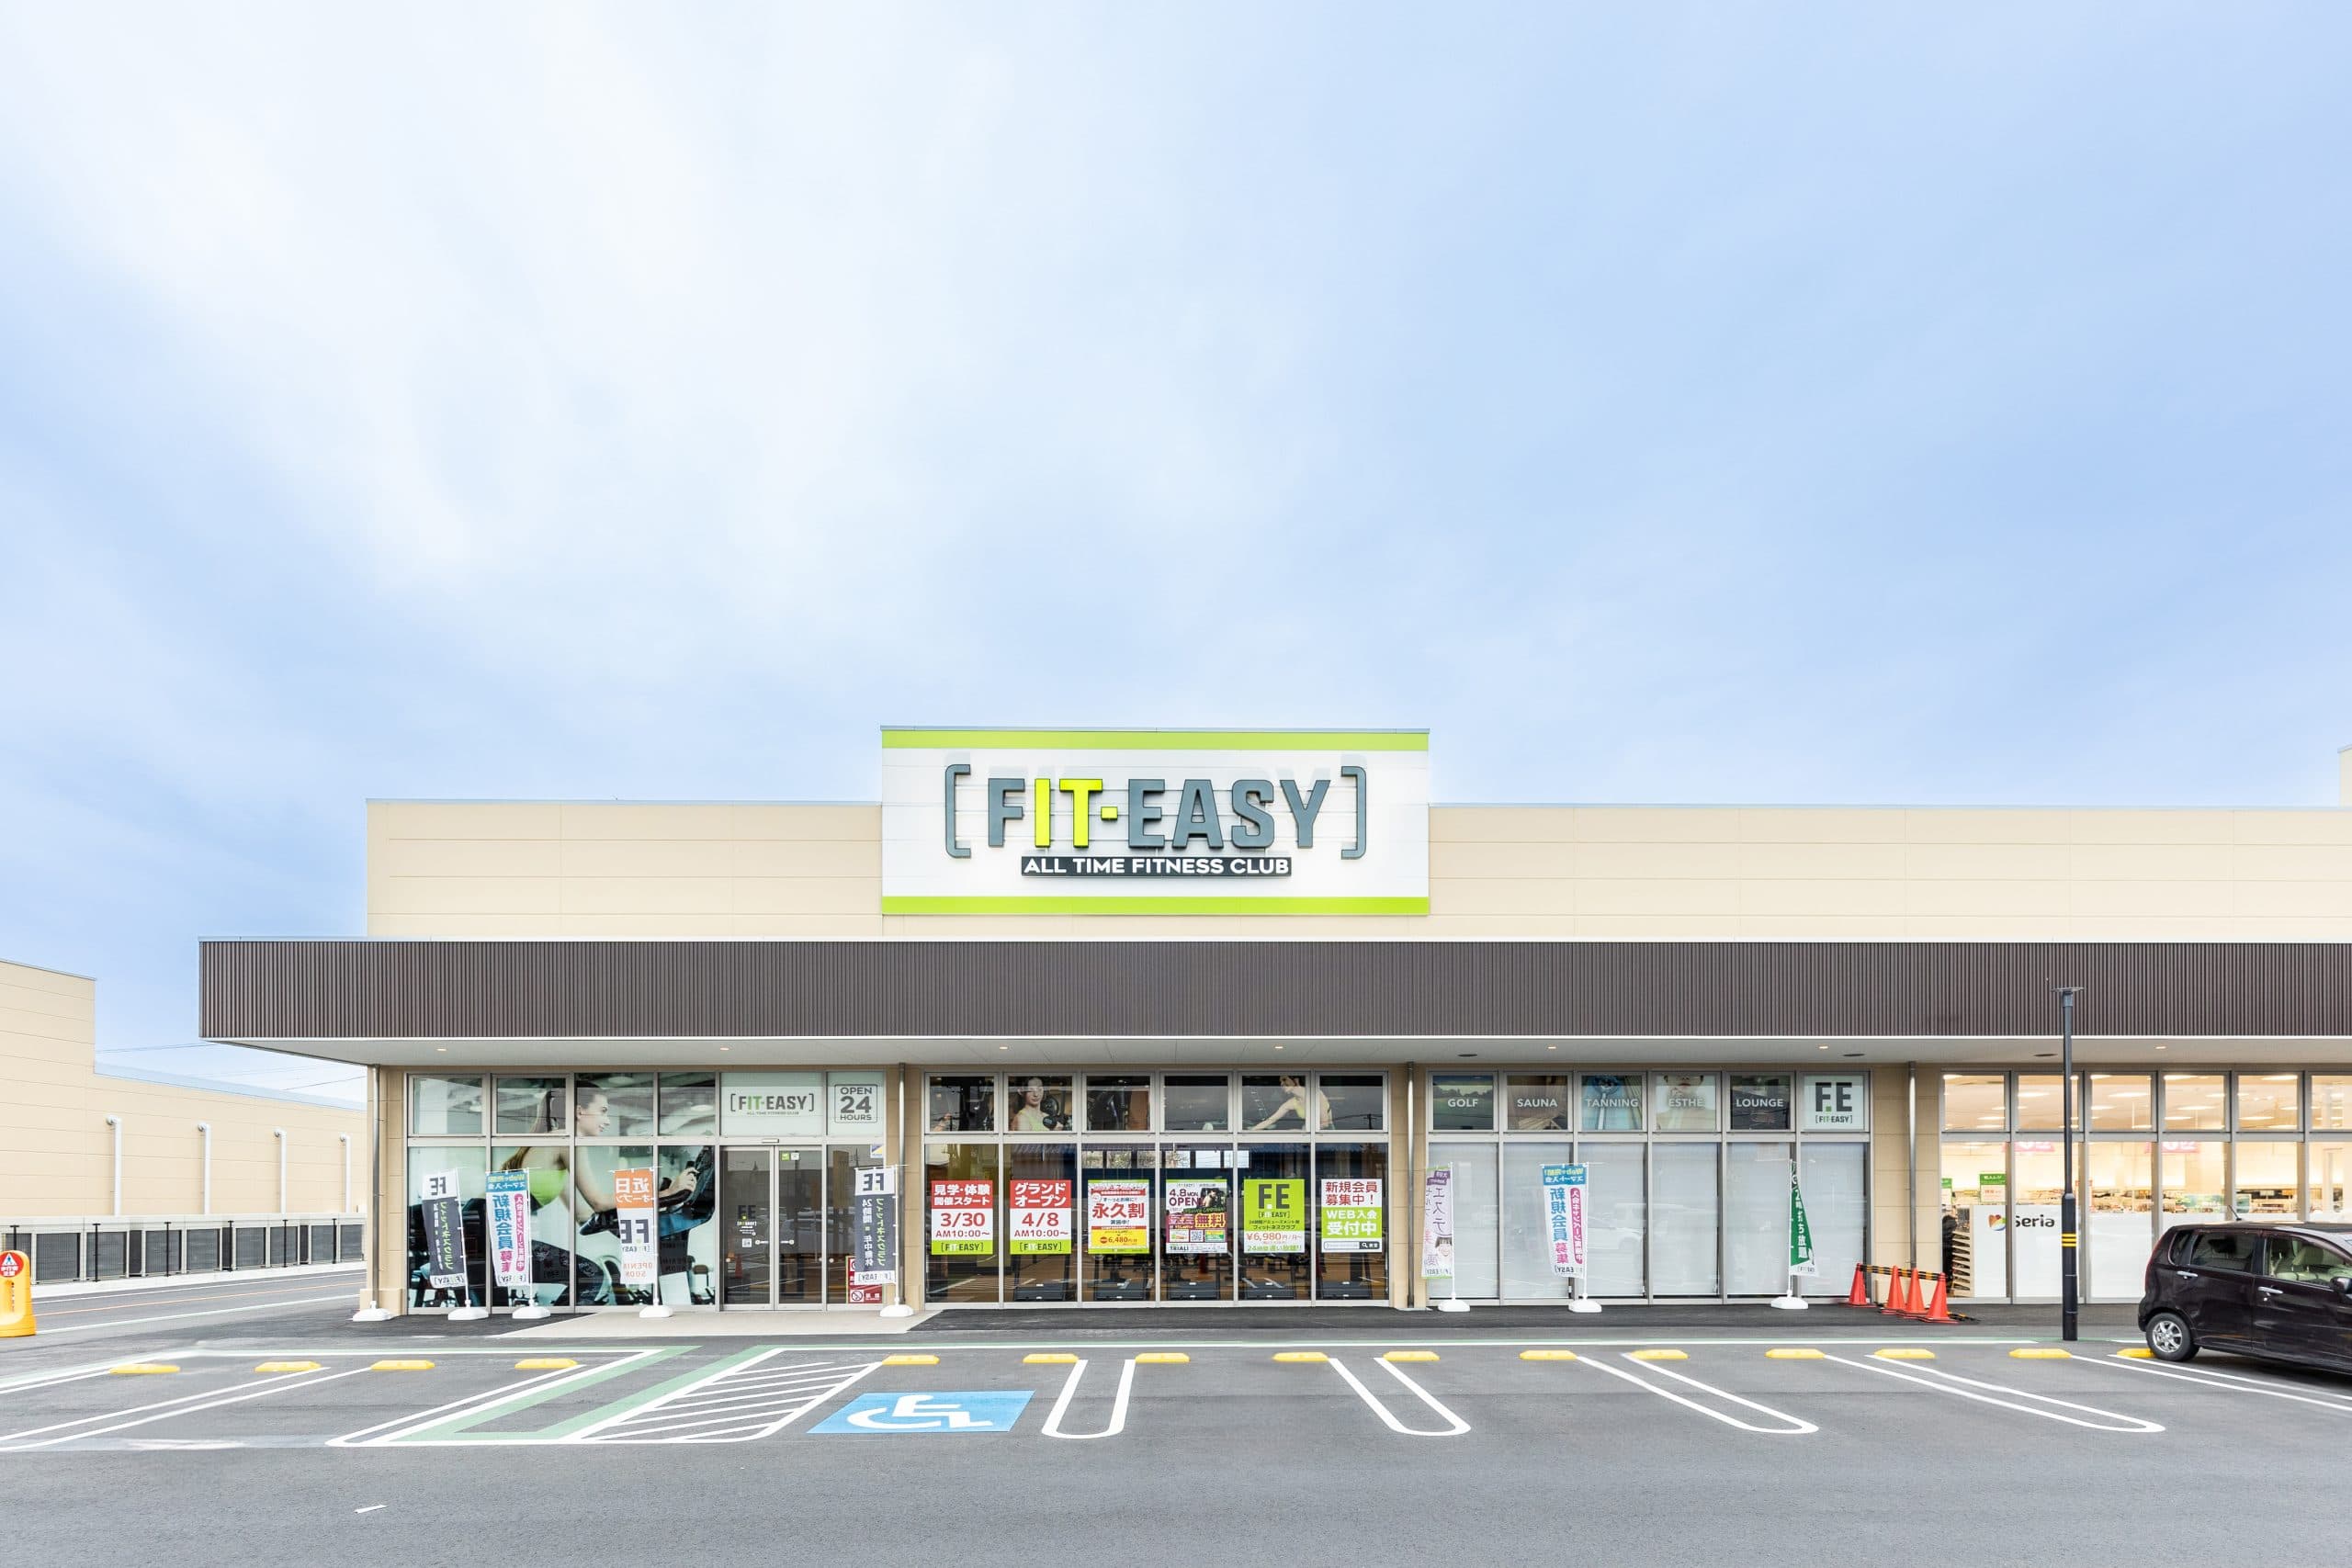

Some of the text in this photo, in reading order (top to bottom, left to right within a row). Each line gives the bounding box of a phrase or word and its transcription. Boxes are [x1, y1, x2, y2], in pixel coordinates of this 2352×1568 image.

[1023, 858, 1289, 875] ALL TIME FITNESS CLUB
[840, 1087, 873, 1095] OPEN
[840, 1096, 872, 1114] 24
[1448, 1099, 1478, 1108] GOLF
[1517, 1099, 1558, 1108] SAUNA
[1585, 1098, 1639, 1108] TANNING
[1668, 1098, 1705, 1108] ESTHE
[1736, 1098, 1784, 1108] LOUNGE
[934, 1183, 991, 1196] 見学・体験
[1014, 1182, 1067, 1195] グランド
[1325, 1181, 1378, 1193] 新規会員
[933, 1196, 990, 1206] 開催スタート
[1014, 1195, 1067, 1207] オープン
[1092, 1202, 1145, 1219] 永久割
[1326, 1209, 1377, 1220] WEB入会
[940, 1212, 986, 1228] 3/30
[1022, 1212, 1059, 1228] 4/8
[1194, 1213, 1227, 1228] 無料
[2015, 1213, 2055, 1228] Seria
[1327, 1221, 1377, 1236] 受付中
